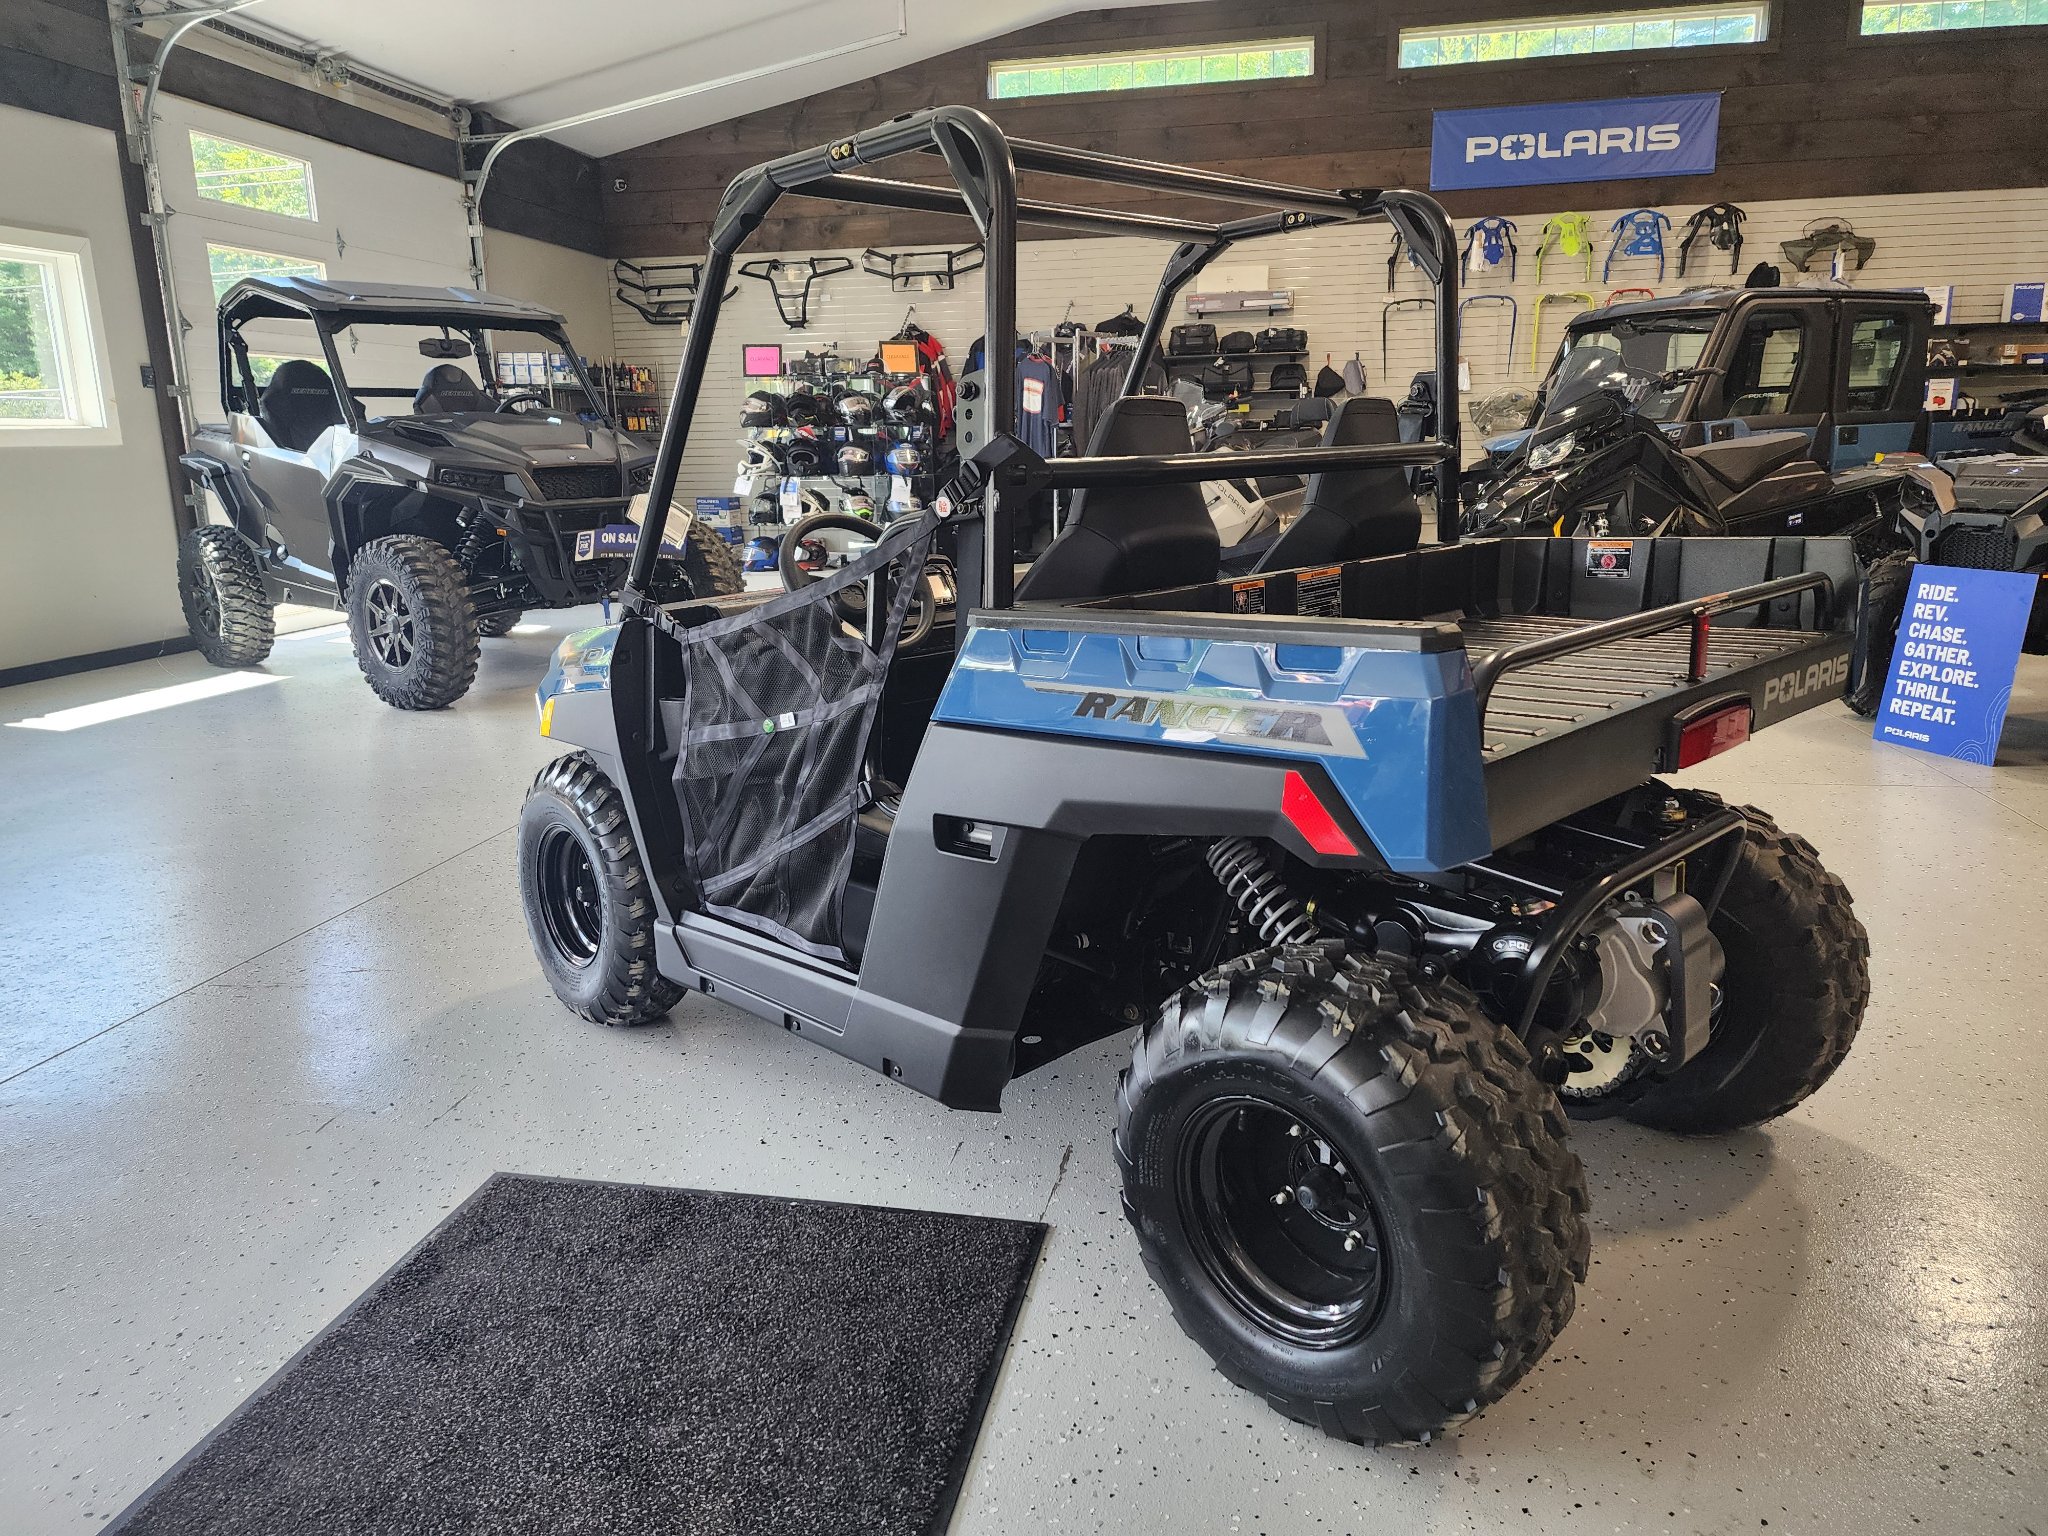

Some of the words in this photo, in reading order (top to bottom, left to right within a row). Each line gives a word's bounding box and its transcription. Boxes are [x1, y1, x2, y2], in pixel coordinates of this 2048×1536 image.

[1465, 123, 1681, 163] POLARIS
[601, 532, 616, 544] ON
[618, 532, 639, 544] SAL
[1917, 583, 1959, 603] RIDE.
[1912, 602, 1949, 622] REV.
[1908, 622, 1967, 645] CHASE.
[1904, 641, 1973, 666] GATHER.
[1763, 653, 1849, 711] POLARIS
[1898, 660, 1979, 688] EXPLORE.
[1896, 679, 1957, 705] THRILL.
[1072, 691, 1334, 747] RANGER
[1889, 697, 1956, 726] REPEAT.
[1884, 726, 1930, 743] POLARIS
